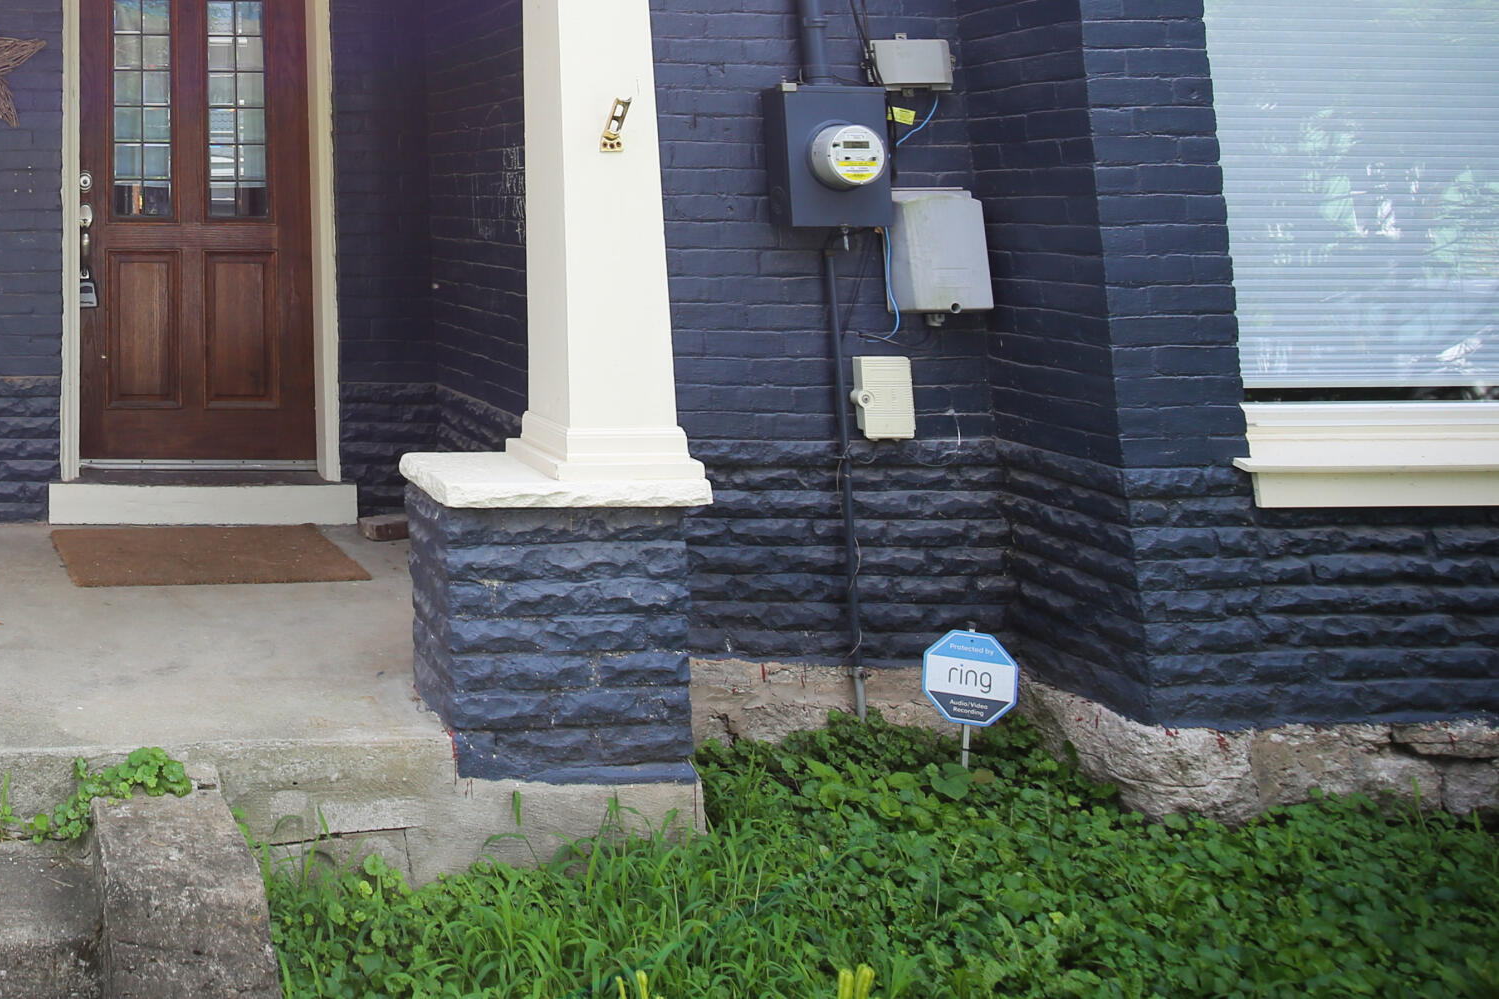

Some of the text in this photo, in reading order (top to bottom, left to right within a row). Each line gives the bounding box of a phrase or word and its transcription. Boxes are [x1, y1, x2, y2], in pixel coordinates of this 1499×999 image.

[949, 643, 995, 656] Protected by
[948, 664, 992, 694] ring
[949, 699, 988, 709] Audio/Video
[953, 706, 985, 717] Recording
